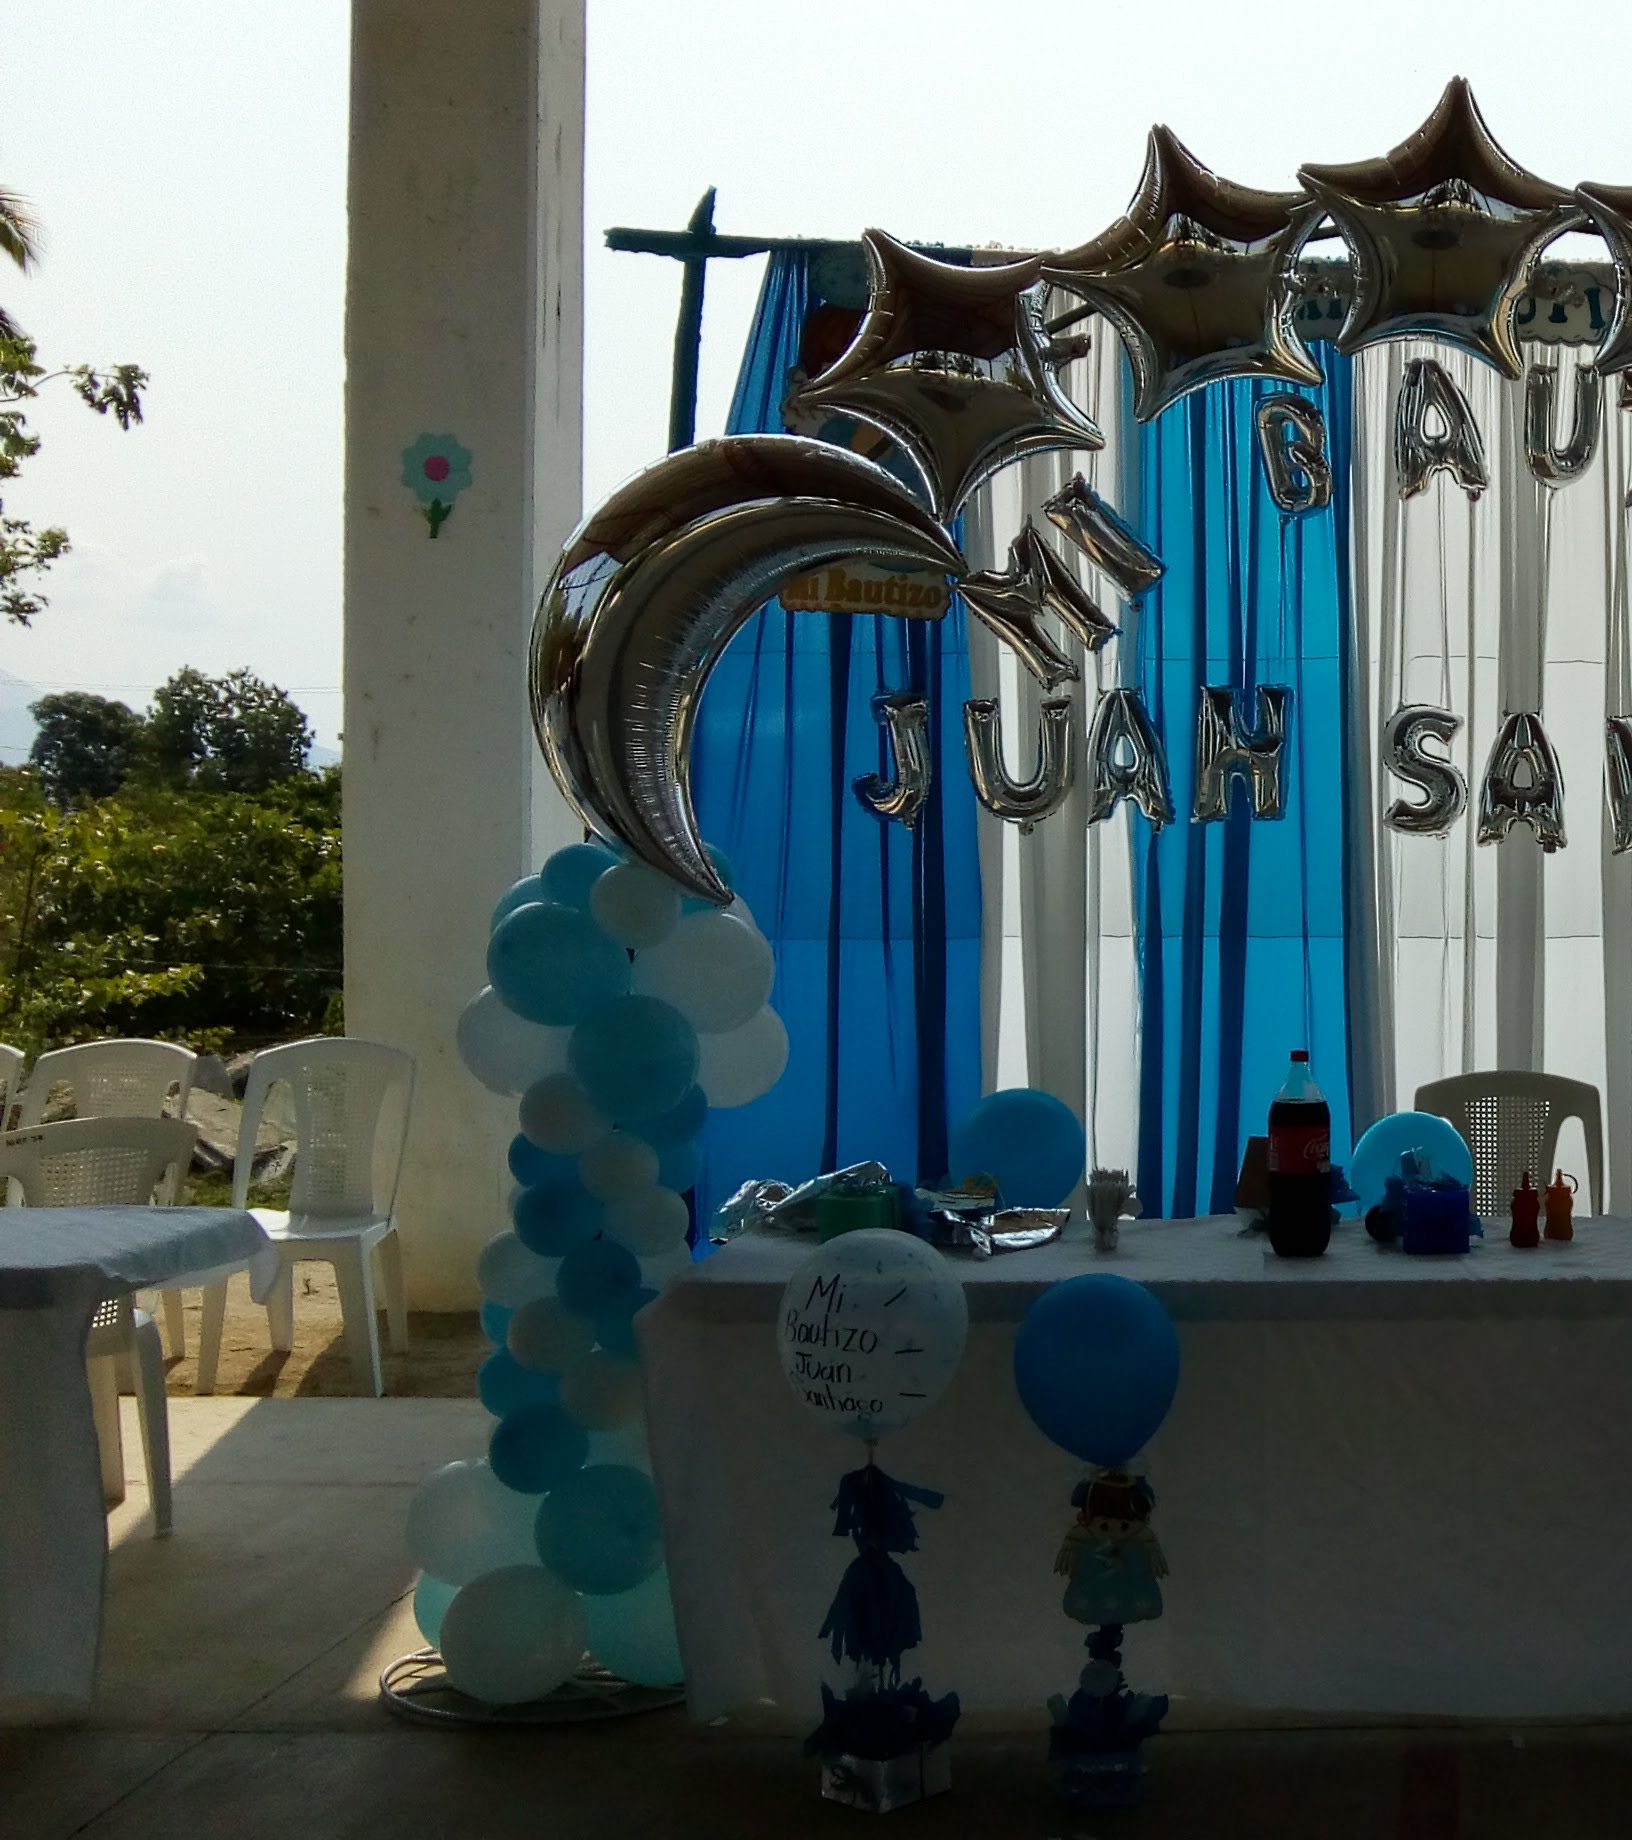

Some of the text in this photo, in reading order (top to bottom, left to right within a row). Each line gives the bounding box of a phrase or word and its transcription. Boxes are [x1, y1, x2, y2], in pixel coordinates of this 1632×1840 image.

[852, 683, 1296, 834] JUAN
[805, 1273, 847, 1313] Mi
[796, 1351, 852, 1384] Juan
